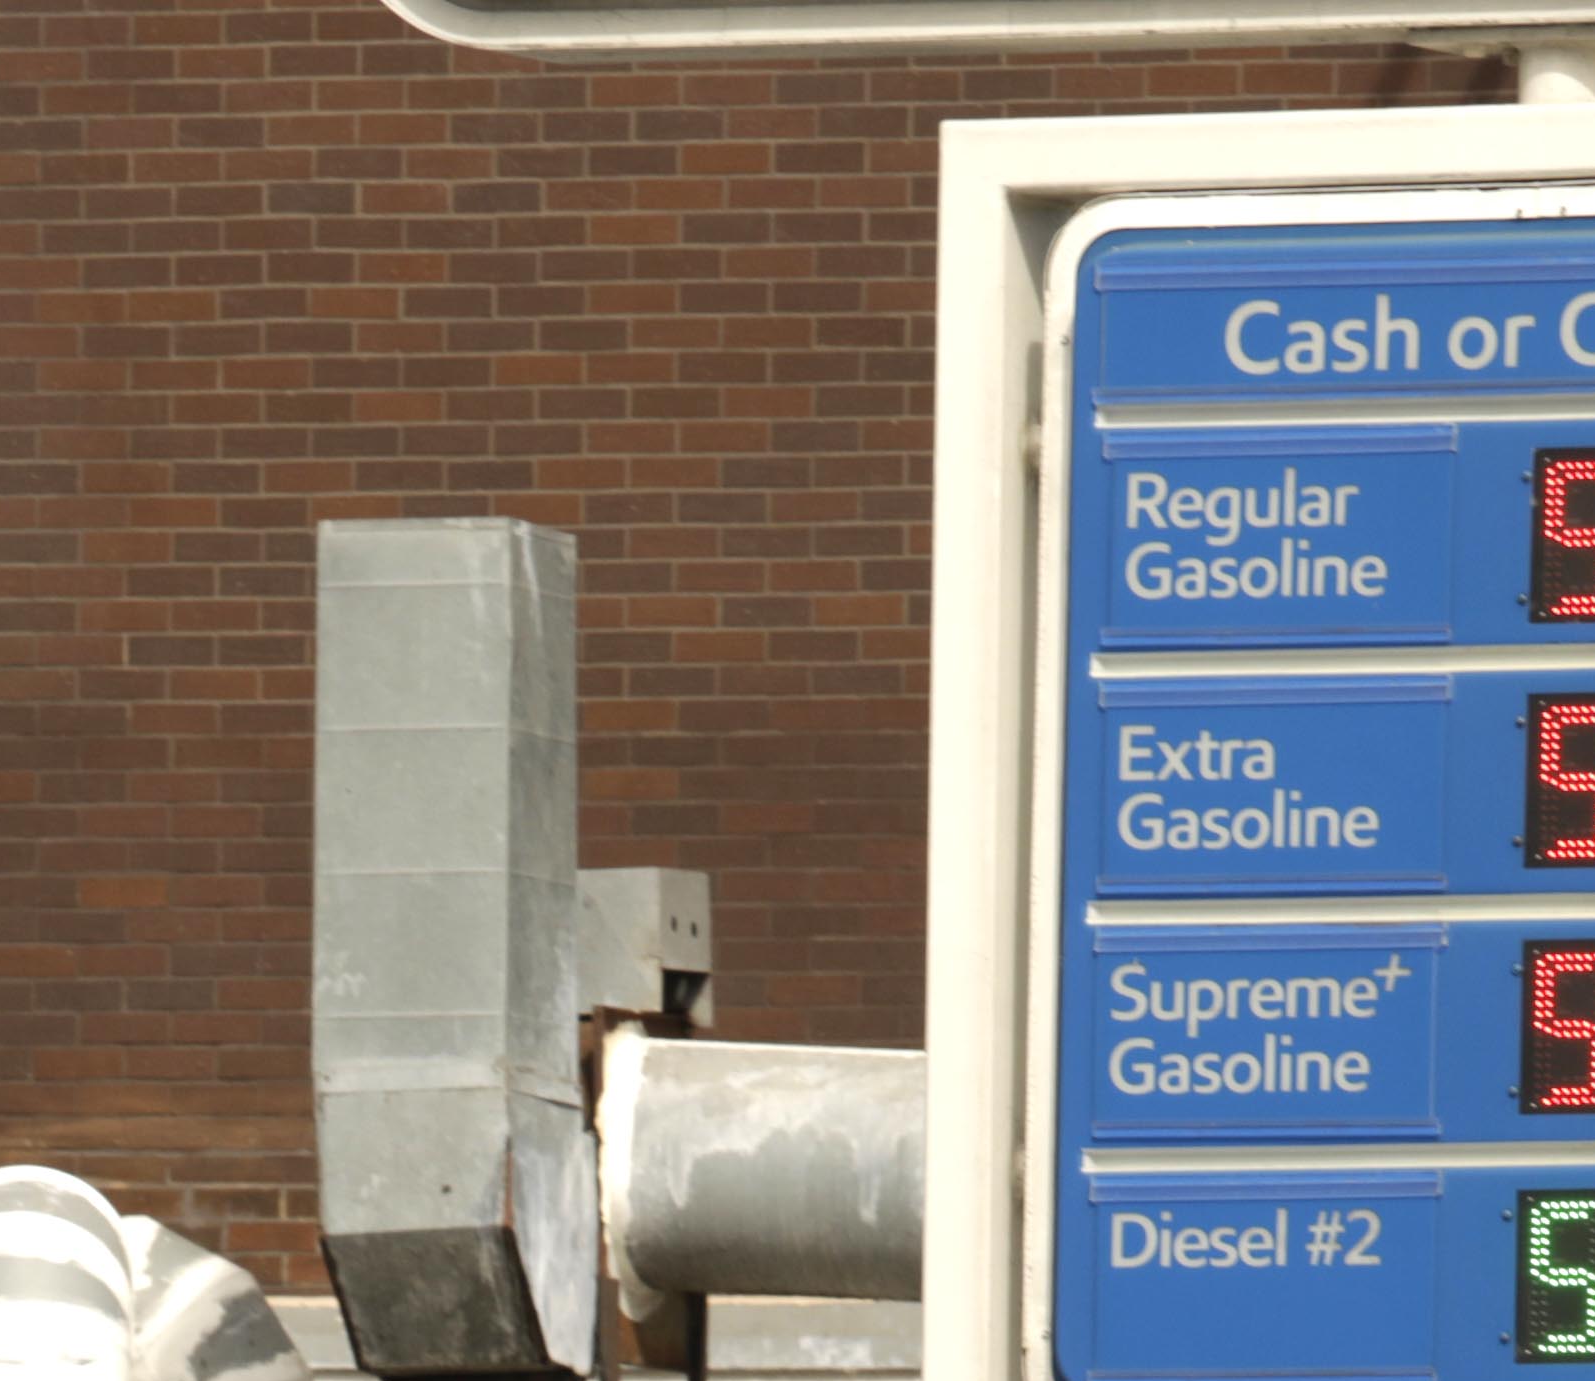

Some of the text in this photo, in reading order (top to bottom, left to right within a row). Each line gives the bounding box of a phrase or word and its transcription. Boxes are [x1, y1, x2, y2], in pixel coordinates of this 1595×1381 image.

[1223, 294, 1420, 376] Cash
[1447, 310, 1535, 369] or
[1124, 466, 1359, 547] Regular
[1123, 537, 1388, 600] Gasoline
[1116, 723, 1277, 783] Extra
[1115, 790, 1381, 850] Gasoline
[1108, 1034, 1372, 1097] Gasoline
[1109, 1208, 1383, 1270] Diesel #2
